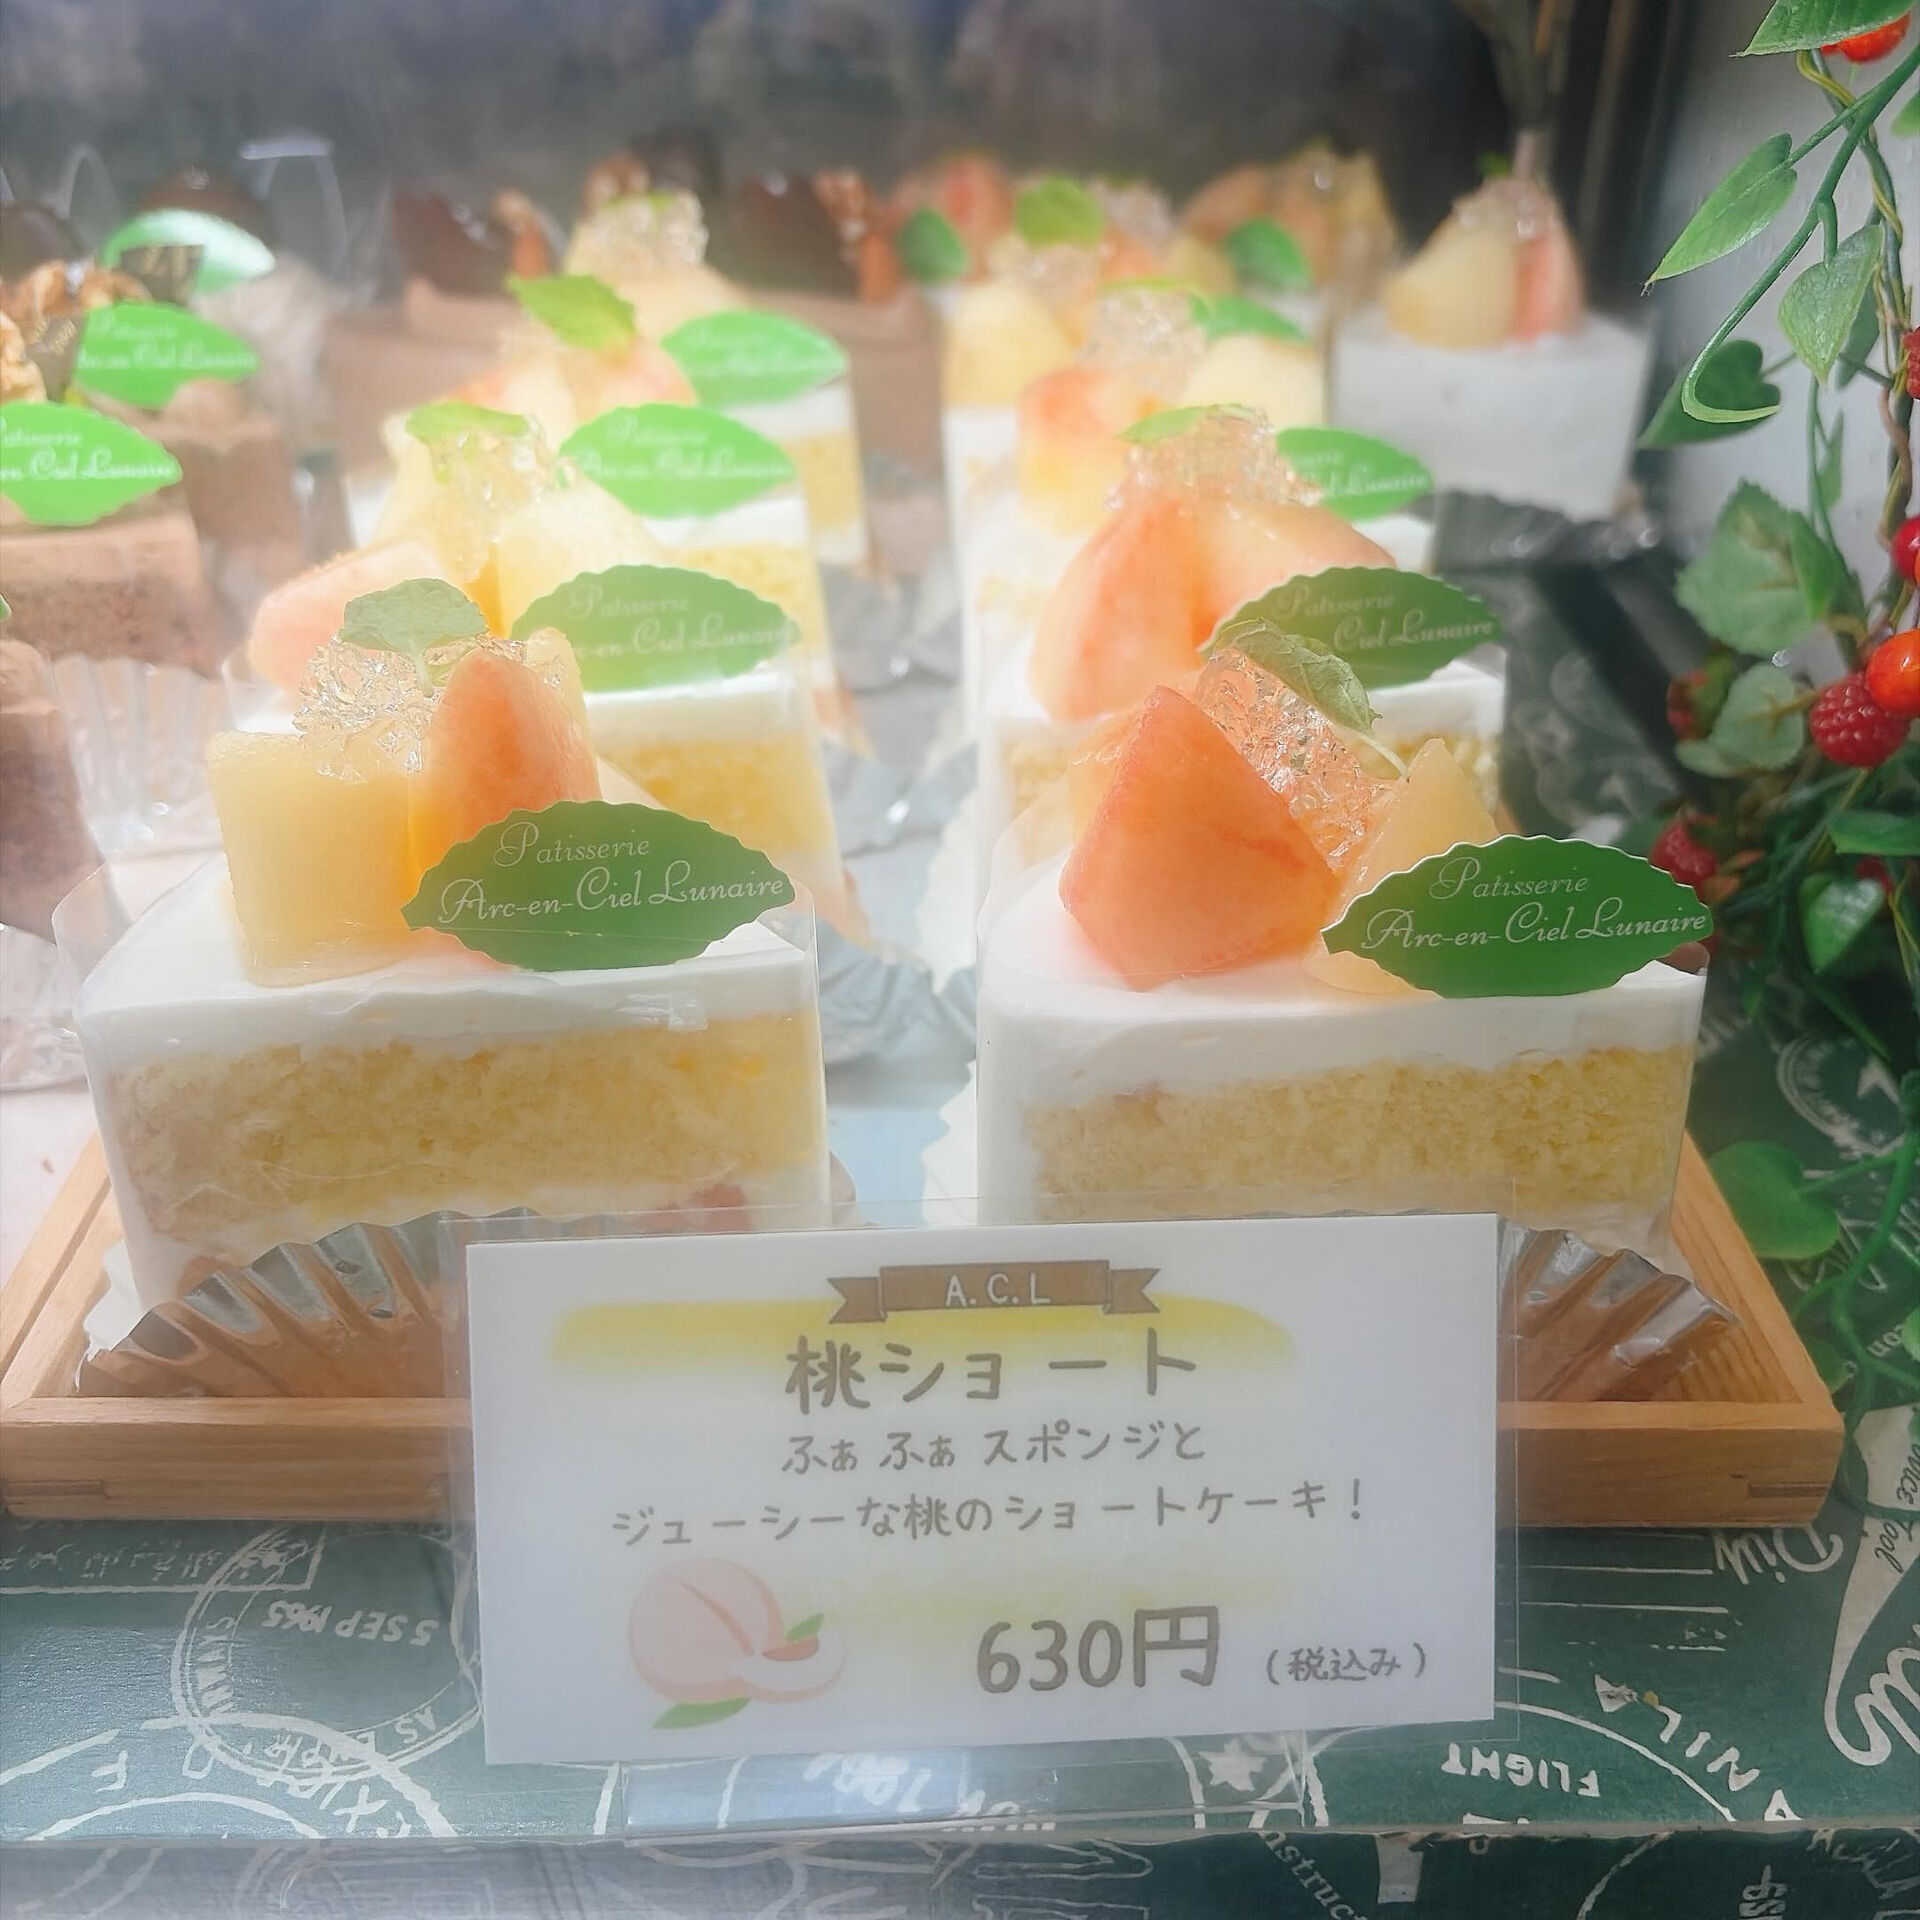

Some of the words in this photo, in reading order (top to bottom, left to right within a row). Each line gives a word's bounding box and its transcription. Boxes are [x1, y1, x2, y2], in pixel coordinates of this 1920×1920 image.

[493, 821, 650, 867] Patisserie
[438, 866, 642, 924] Arc-en-Ciel
[648, 859, 784, 906] Lunaire
[1429, 856, 1588, 900] Patisserie
[1361, 902, 1575, 950] Arc-en-Ciel
[1575, 897, 1708, 939] Lunaire
[945, 1273, 1052, 1307] A.C.L
[784, 1326, 1197, 1415] 桃ショート
[335, 1610, 408, 1643] SEP
[410, 1618, 440, 1646] 5
[976, 1605, 1220, 1694] 630円
[1441, 1743, 1601, 1798] FLIGHT
